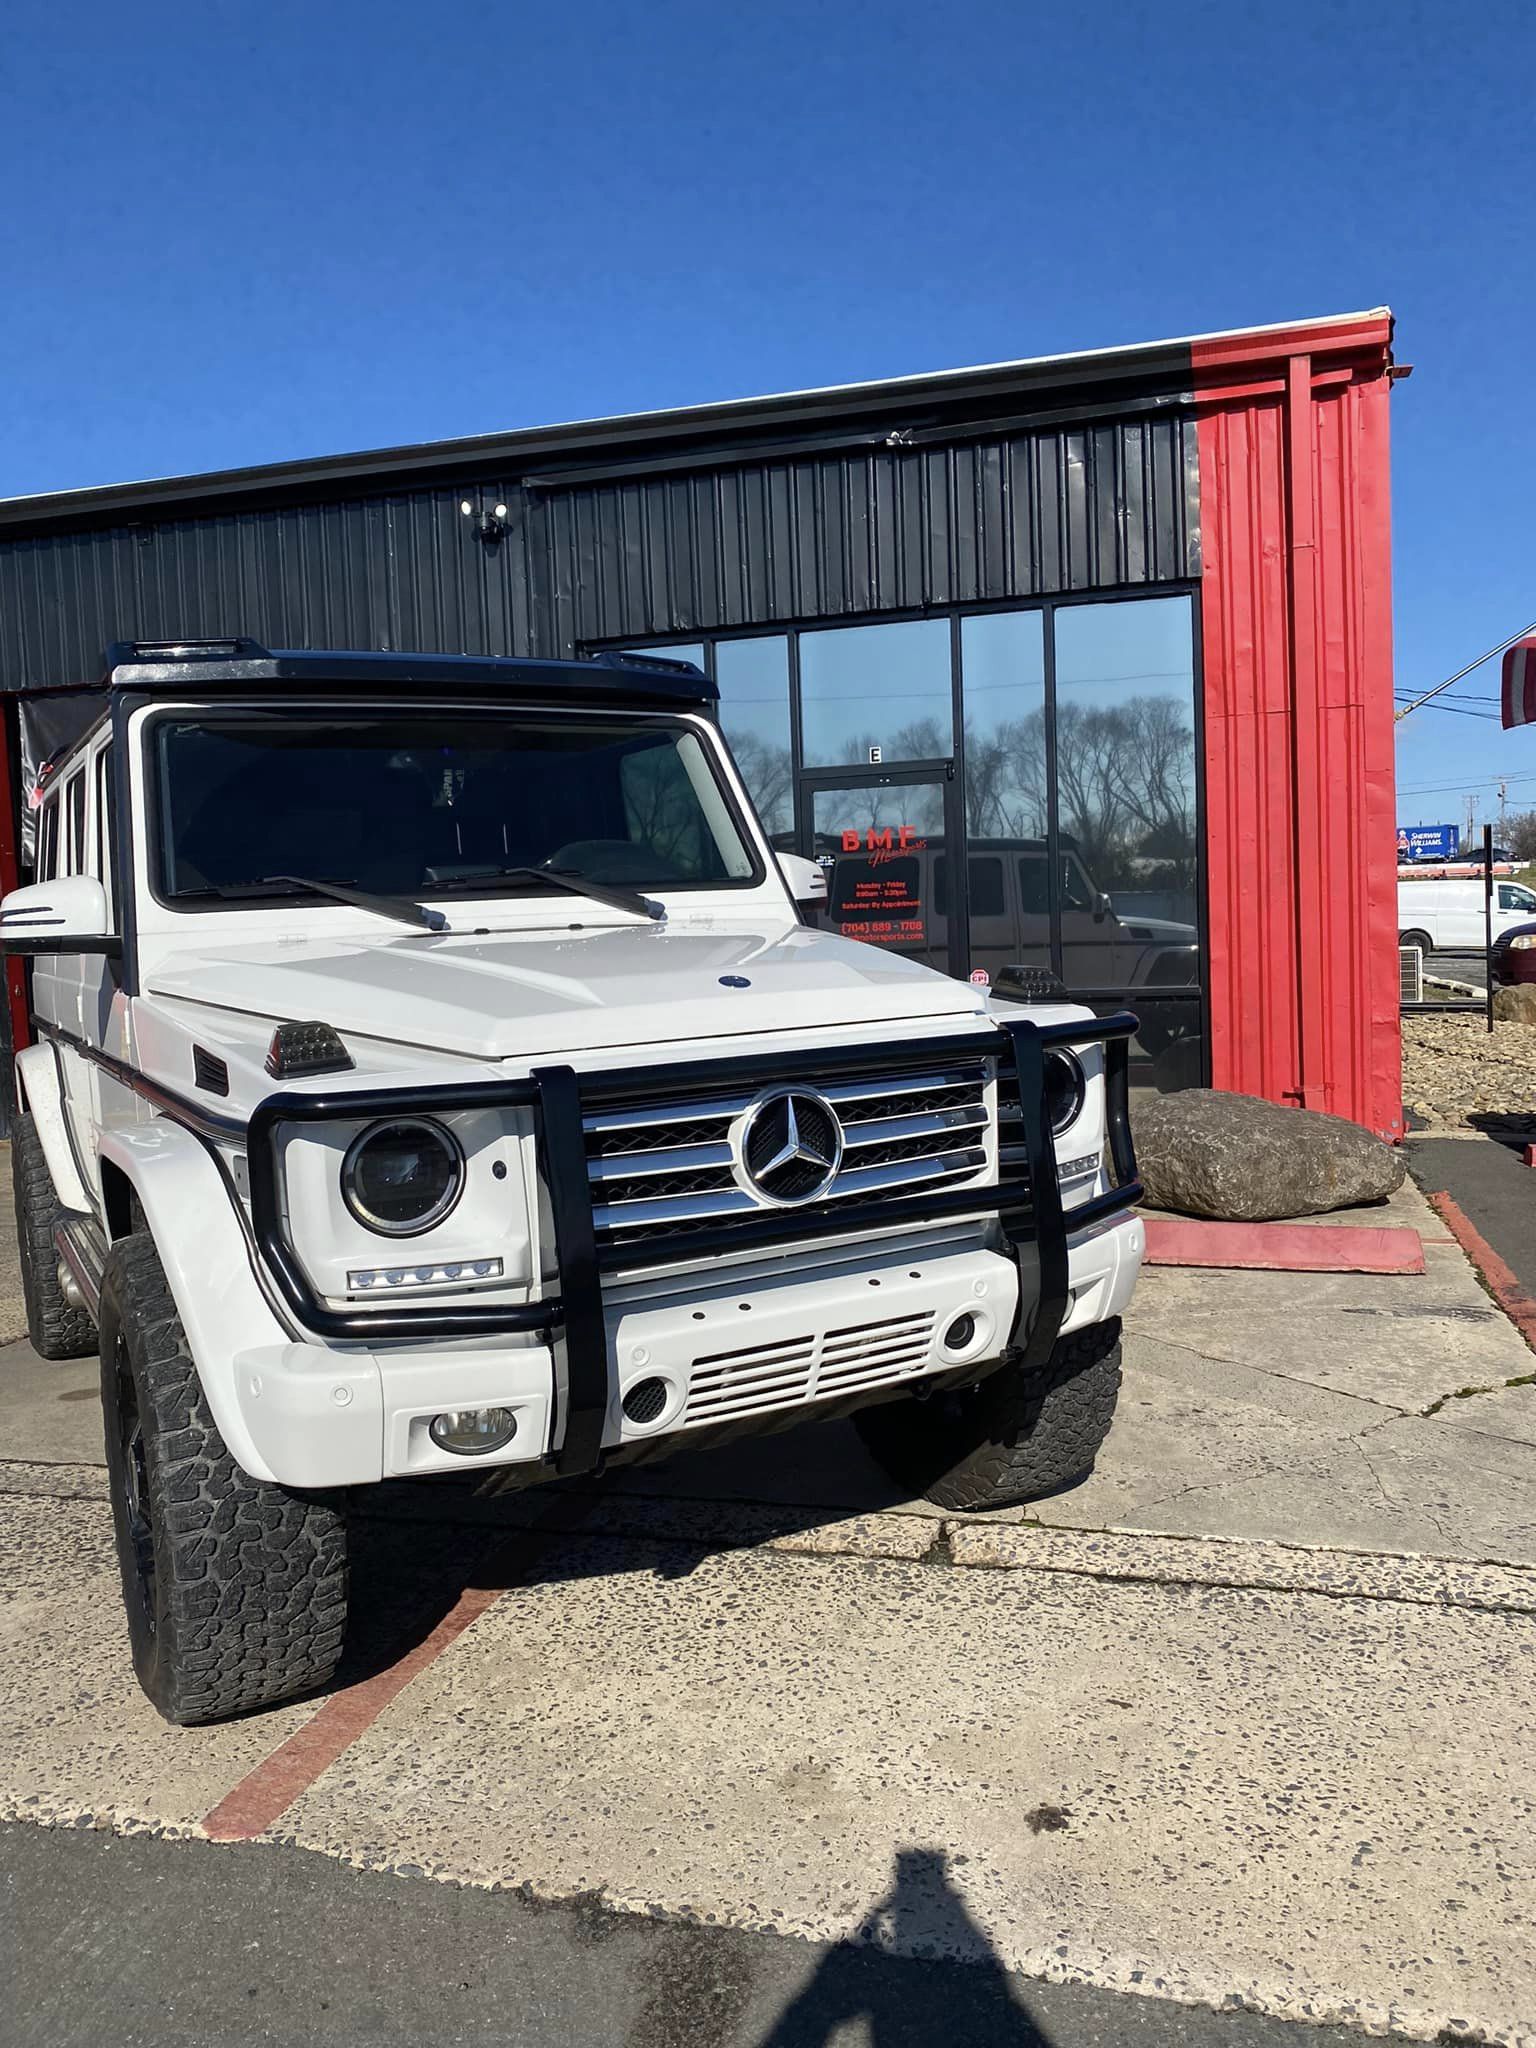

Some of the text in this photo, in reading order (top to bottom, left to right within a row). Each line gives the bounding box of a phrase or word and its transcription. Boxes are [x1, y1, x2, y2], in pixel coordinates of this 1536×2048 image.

[871, 748, 880, 762] E
[1411, 832, 1441, 840] SHERWIN
[882, 900, 921, 909] Appointment
[842, 922, 869, 934] (704)
